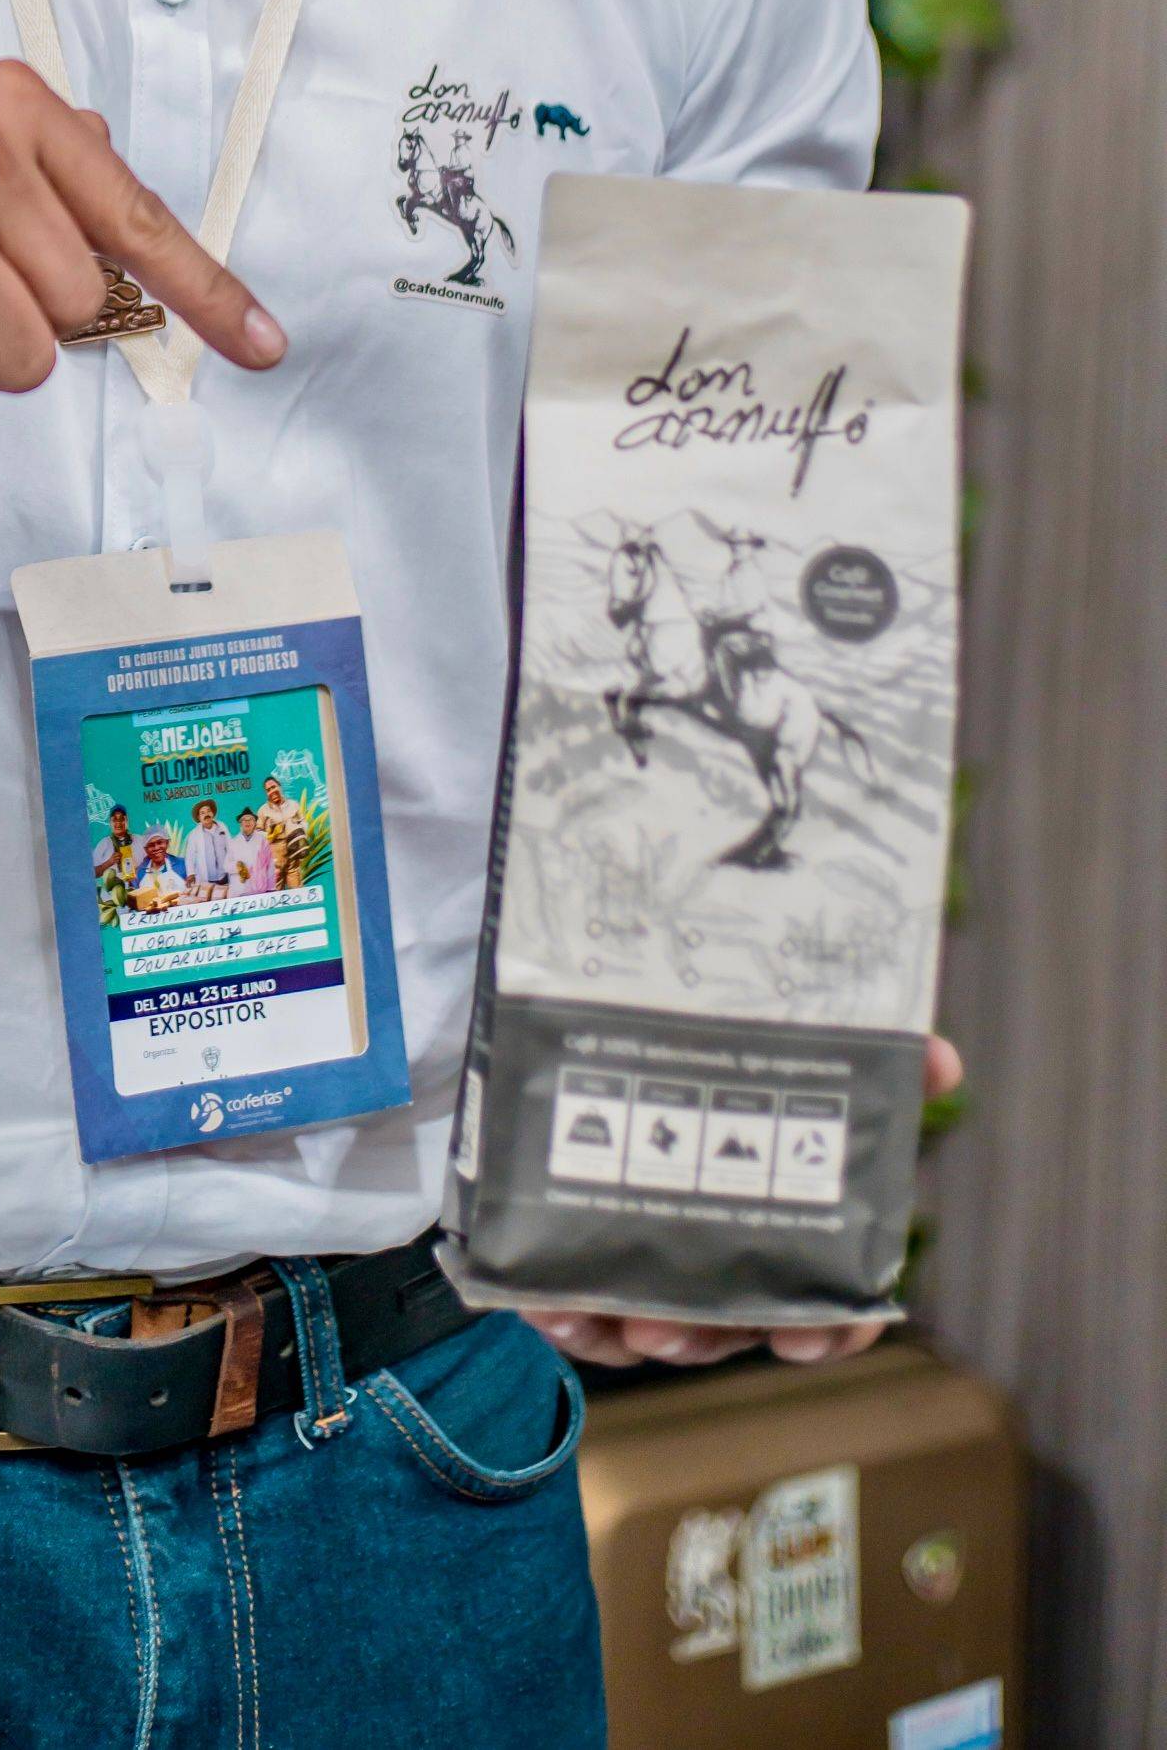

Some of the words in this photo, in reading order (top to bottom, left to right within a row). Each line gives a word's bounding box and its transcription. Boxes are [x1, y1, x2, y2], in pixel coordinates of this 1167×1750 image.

[408, 64, 470, 99] don
[393, 278, 504, 310] @cafedonarnulfo
[624, 326, 755, 406] don
[118, 655, 132, 669] EN
[134, 648, 186, 667] CORFERIAS
[188, 641, 225, 659] JUNTOS
[227, 634, 284, 655] GENERAMOS
[107, 661, 216, 693] OPORTUNIDADES
[218, 660, 228, 678] Y
[231, 650, 299, 676] PROGRESO
[127, 907, 198, 926] CRISTIAN
[134, 998, 158, 1014] DEL
[159, 991, 181, 1009] 20
[181, 991, 199, 1006] AL
[199, 985, 220, 1003] 23
[221, 984, 238, 999] DE
[239, 978, 277, 998] JUNIO
[149, 1001, 267, 1037] EXPOSITOR
[226, 1090, 284, 1112] corferias
